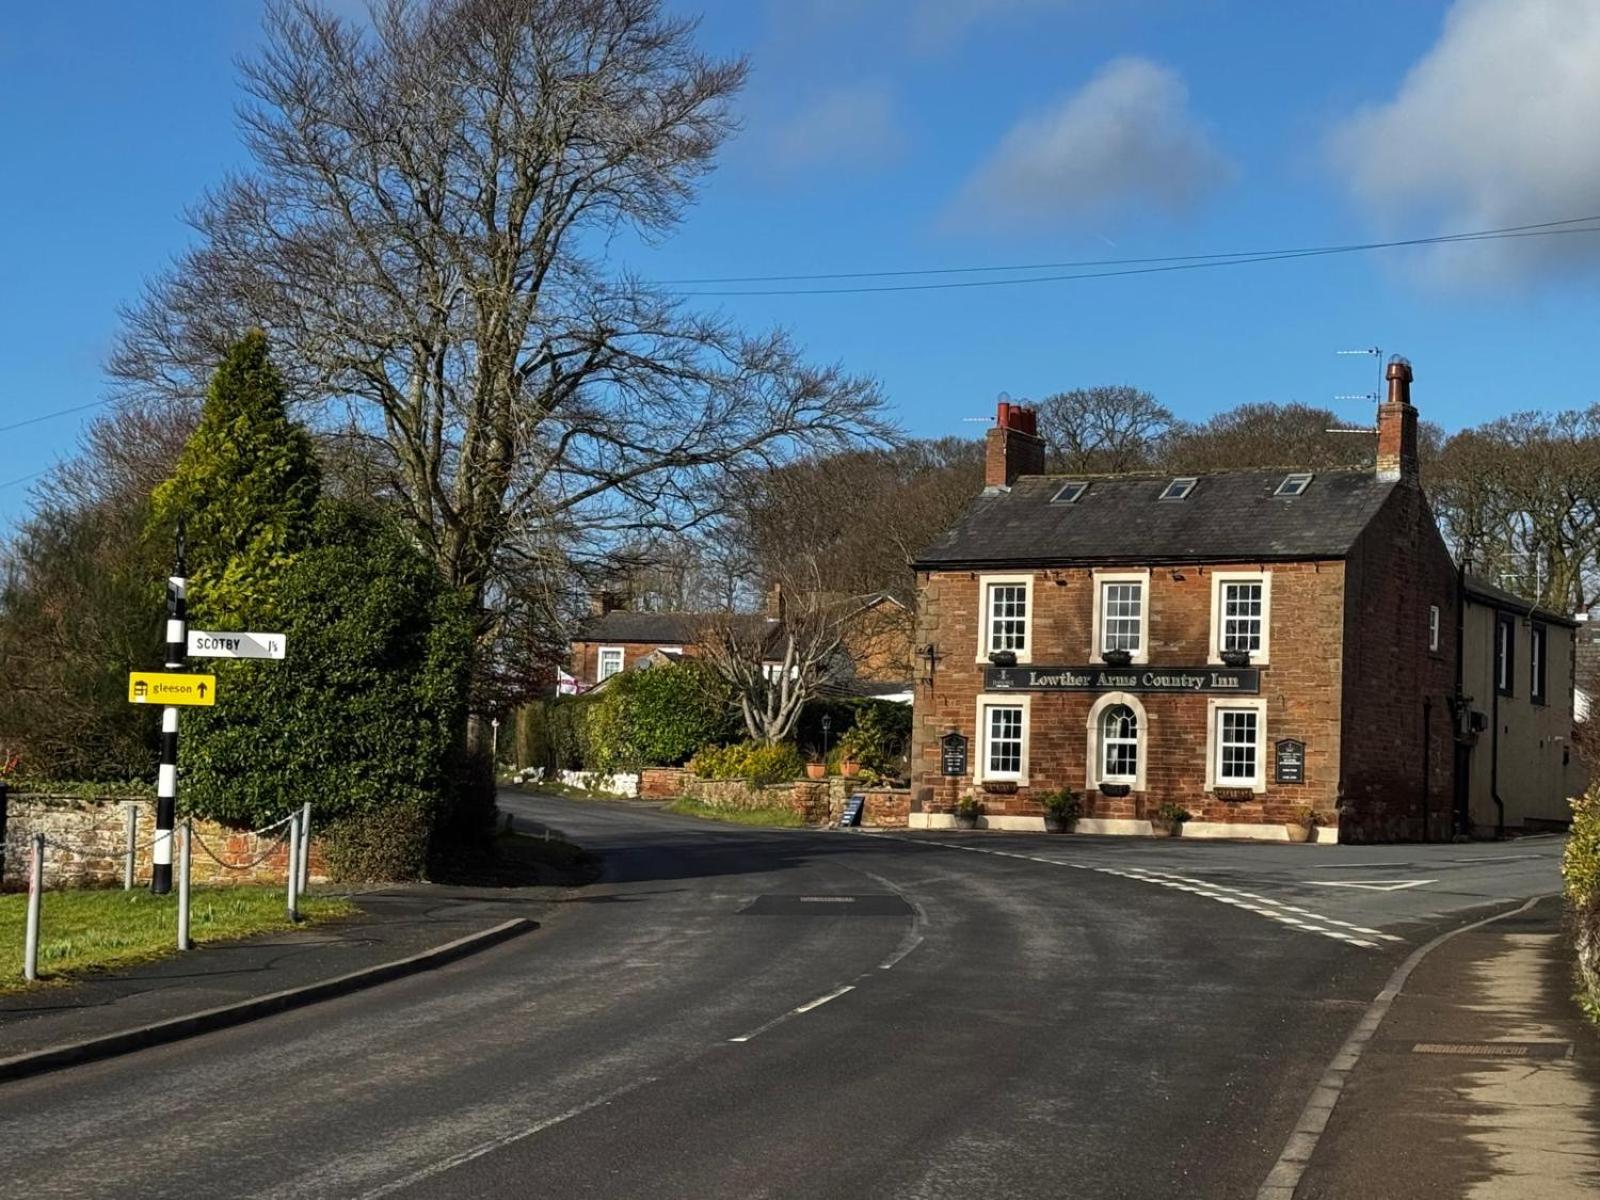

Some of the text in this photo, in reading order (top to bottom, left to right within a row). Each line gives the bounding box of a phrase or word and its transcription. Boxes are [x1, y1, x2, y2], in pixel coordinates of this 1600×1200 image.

[197, 638, 240, 650] SCOTBY
[1029, 672, 1091, 686] Lowther
[1096, 672, 1137, 686] Arms
[1142, 672, 1205, 690] Country
[1211, 673, 1239, 687] Inn
[153, 683, 192, 694] gleeson
